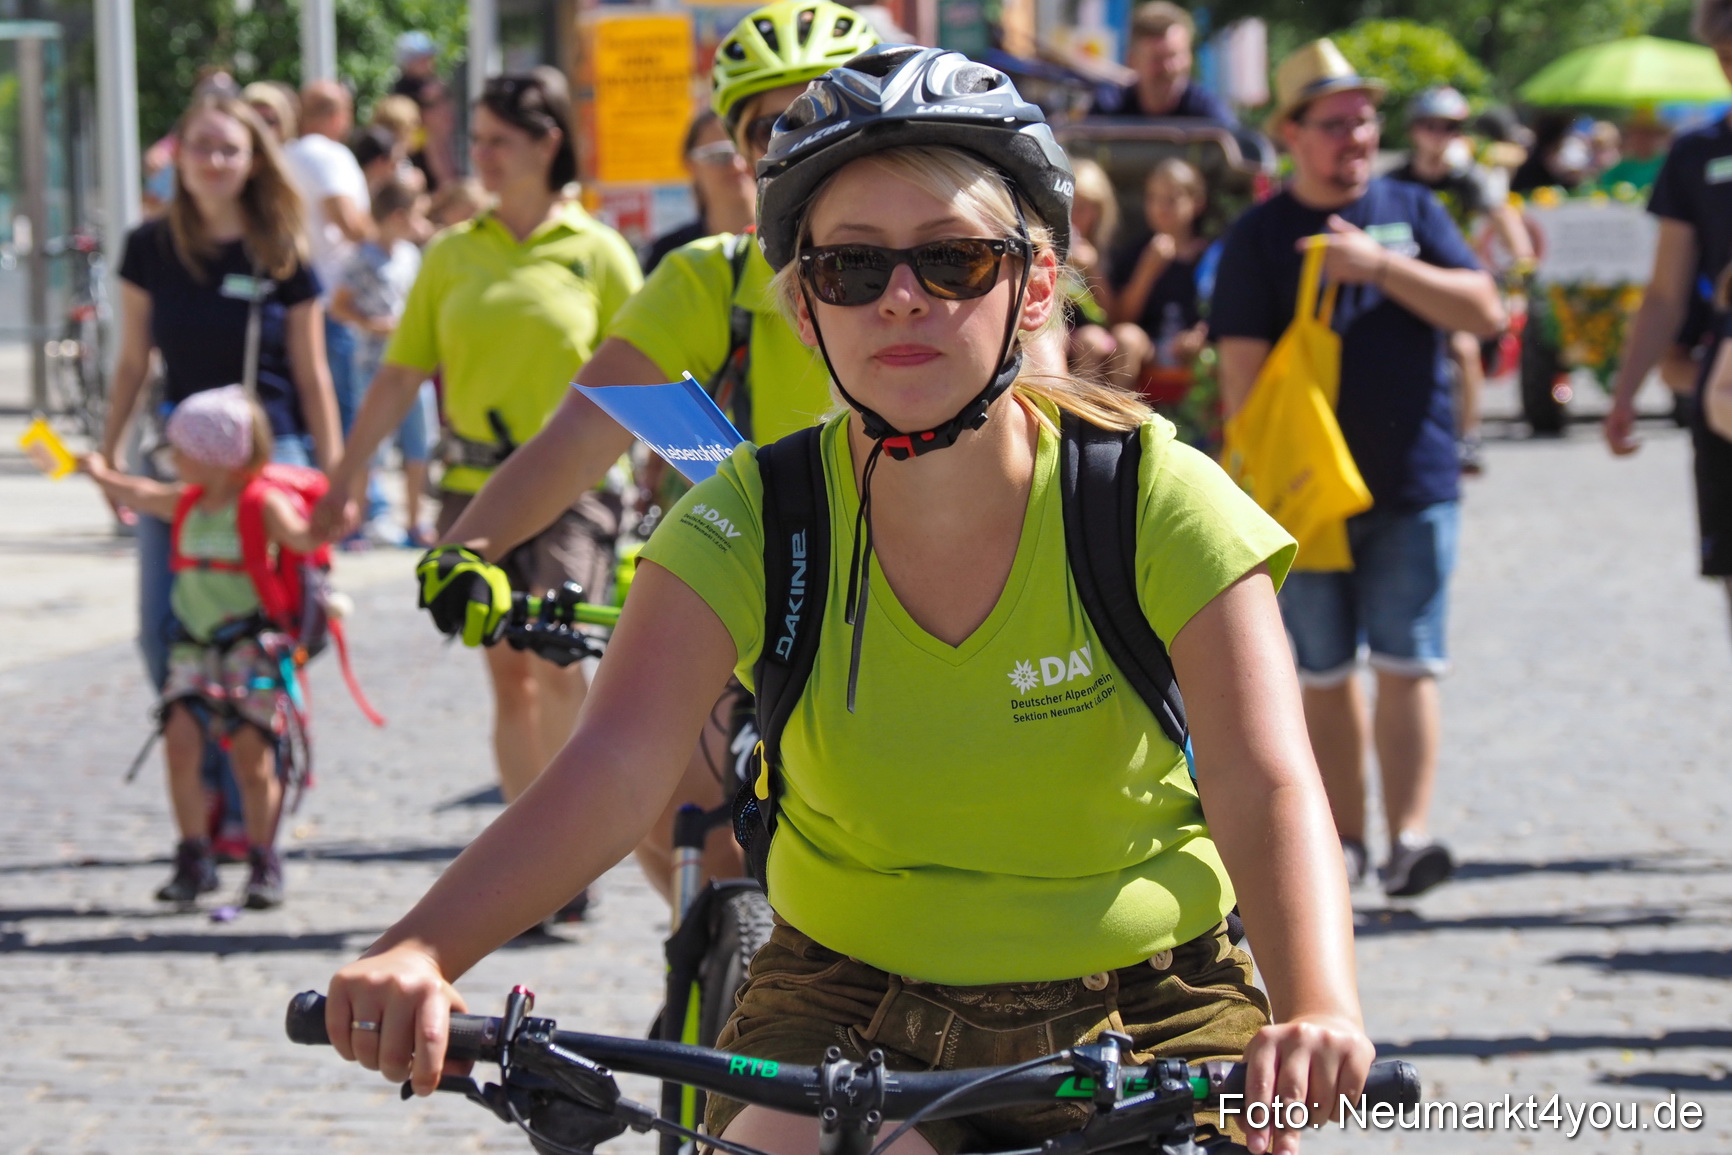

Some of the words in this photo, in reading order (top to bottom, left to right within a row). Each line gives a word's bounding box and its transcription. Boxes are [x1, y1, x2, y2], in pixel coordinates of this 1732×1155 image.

[916, 105, 984, 115] LAZER
[788, 119, 851, 153] LAZER
[703, 508, 742, 538] DAV
[775, 528, 807, 661] DAKINE
[1010, 693, 1063, 710] Deutscher
[1013, 710, 1049, 724] Sektion
[1050, 700, 1094, 718] Neumarkt
[729, 1055, 779, 1078] RTB
